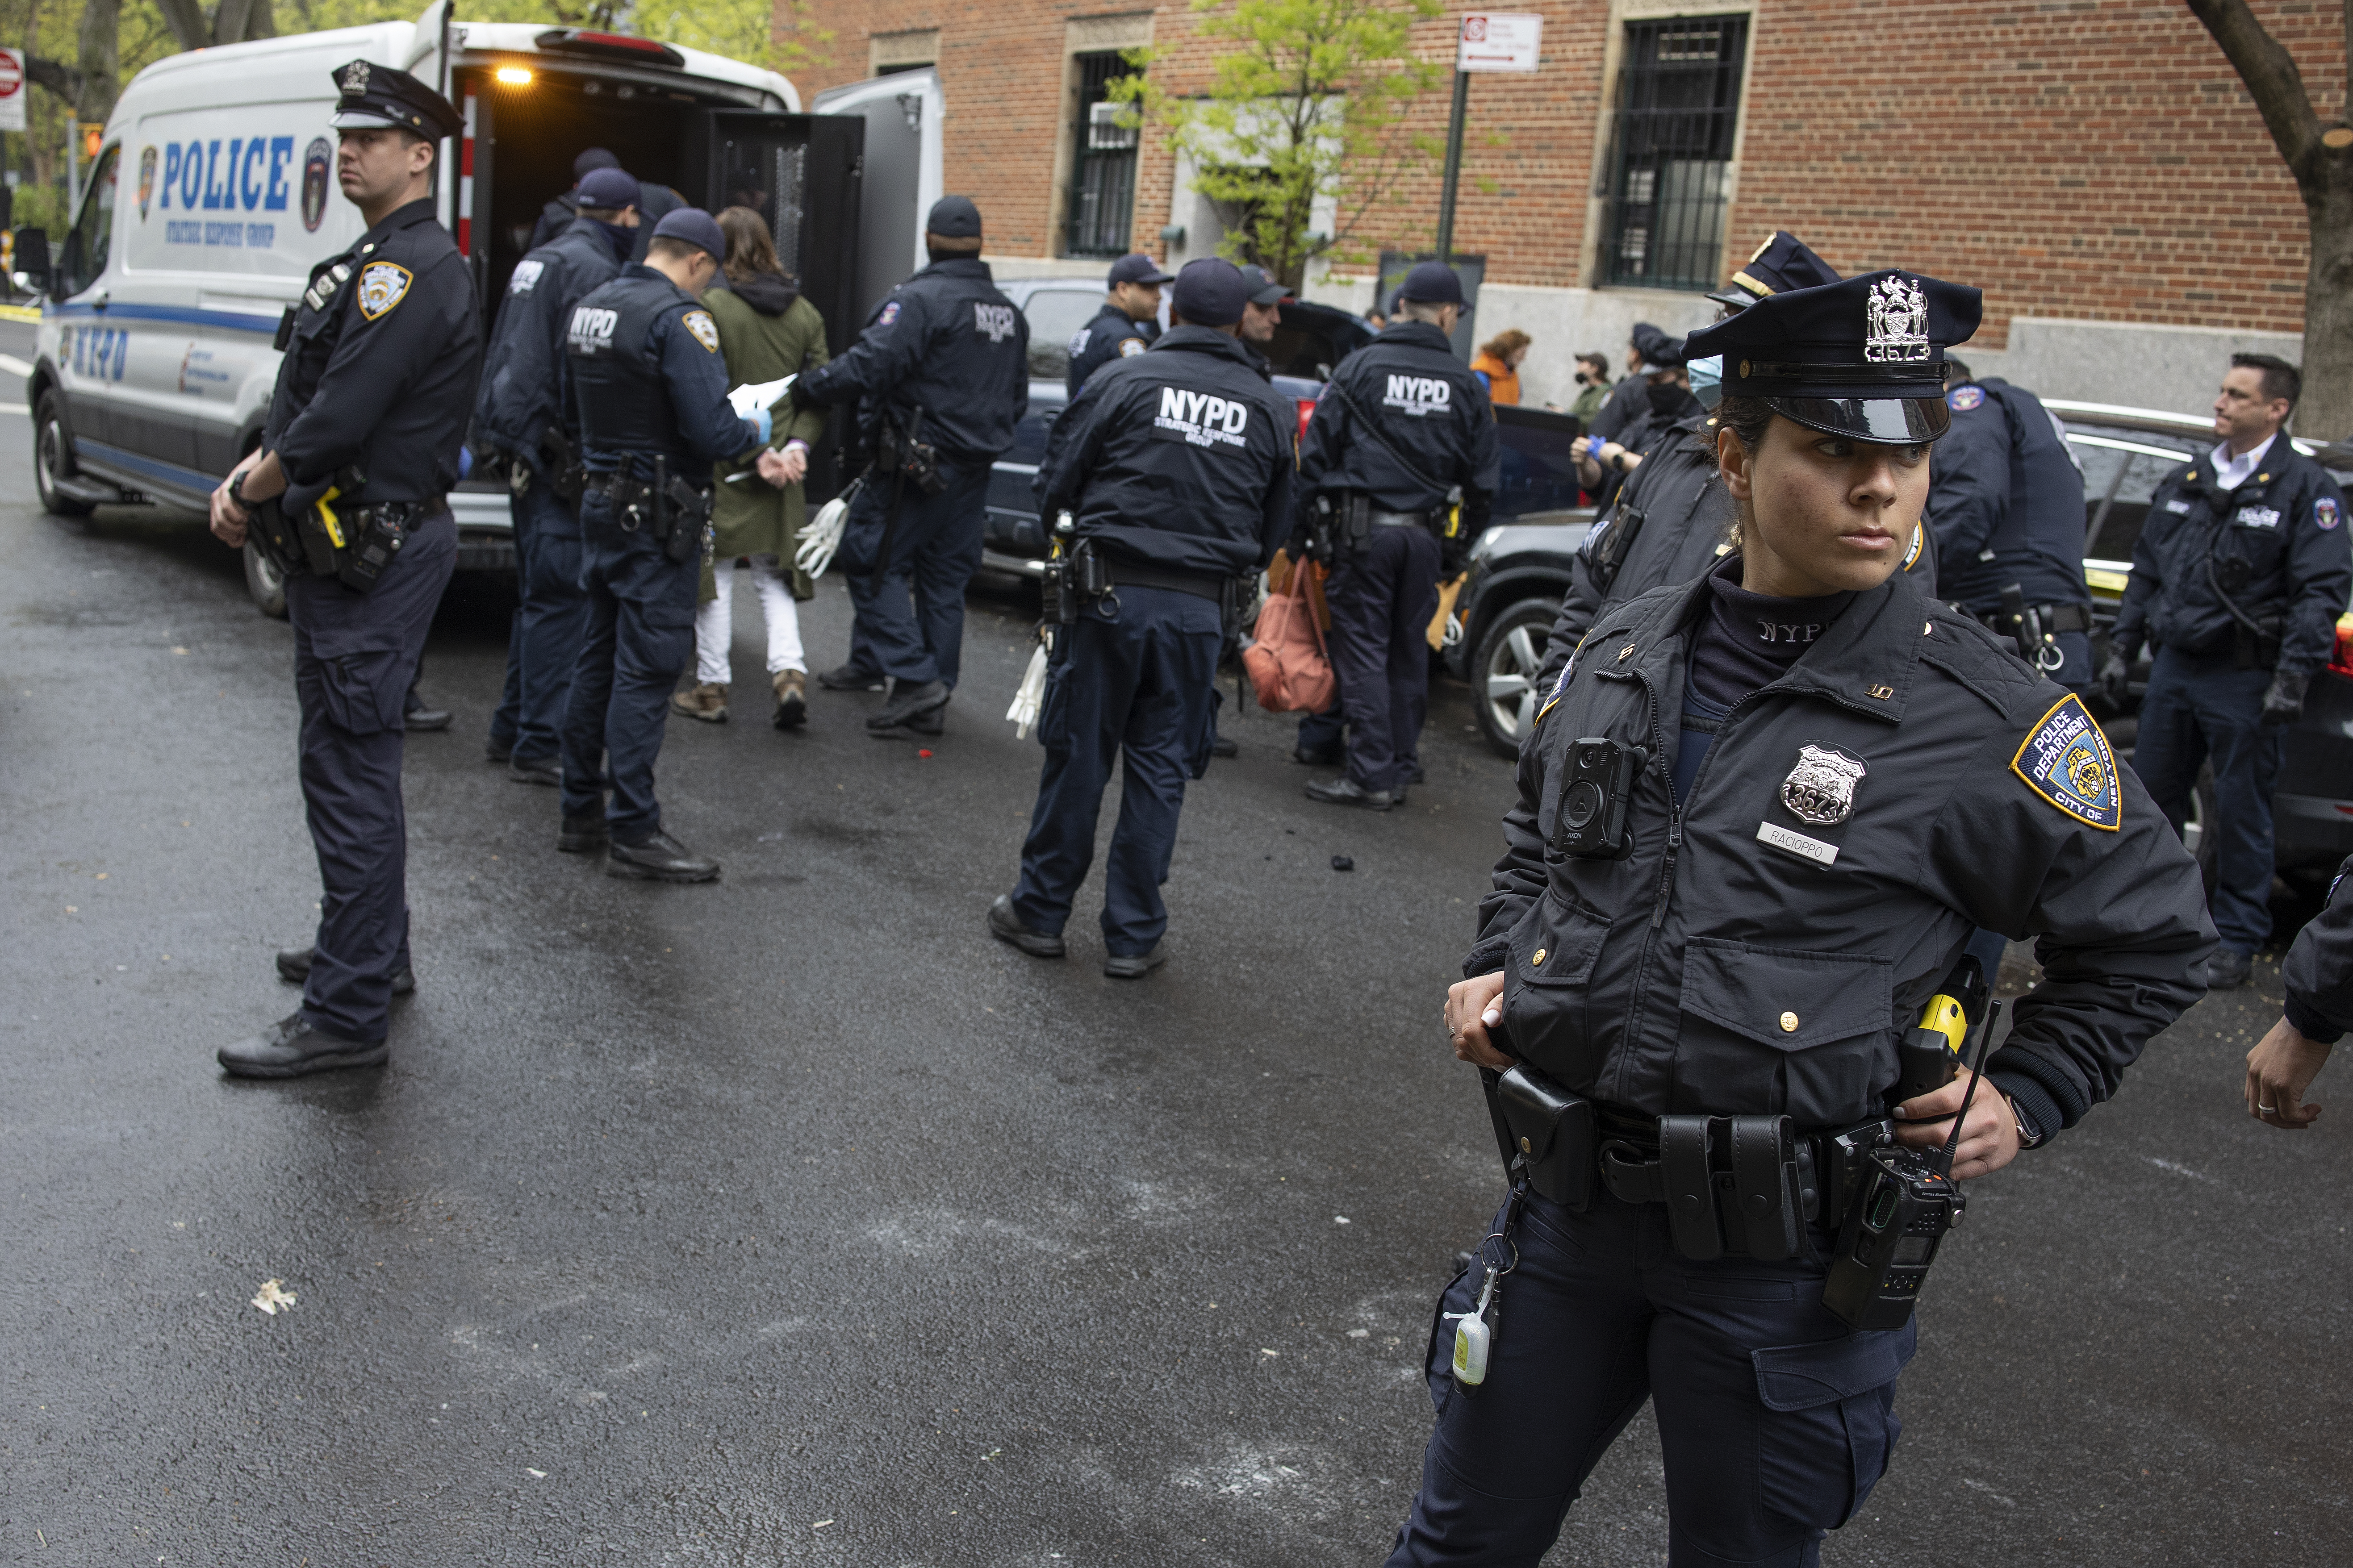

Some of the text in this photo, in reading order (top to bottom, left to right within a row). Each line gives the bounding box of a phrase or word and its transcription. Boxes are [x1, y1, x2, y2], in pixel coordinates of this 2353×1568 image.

[160, 136, 294, 211] POLICE
[571, 307, 618, 338] NYPD
[1871, 343, 1927, 362] 3673
[1387, 374, 1450, 403] NYPD
[1160, 387, 1247, 434] NYPD
[1864, 684, 1893, 701] 10
[2033, 715, 2088, 781] DEPARTMENT
[2034, 711, 2070, 753] POLICE
[2094, 730, 2117, 807] NEW YORK
[1790, 785, 1840, 820] 3673
[2055, 792, 2102, 821] CITY OF
[1770, 830, 1822, 857] RACIOPPO
